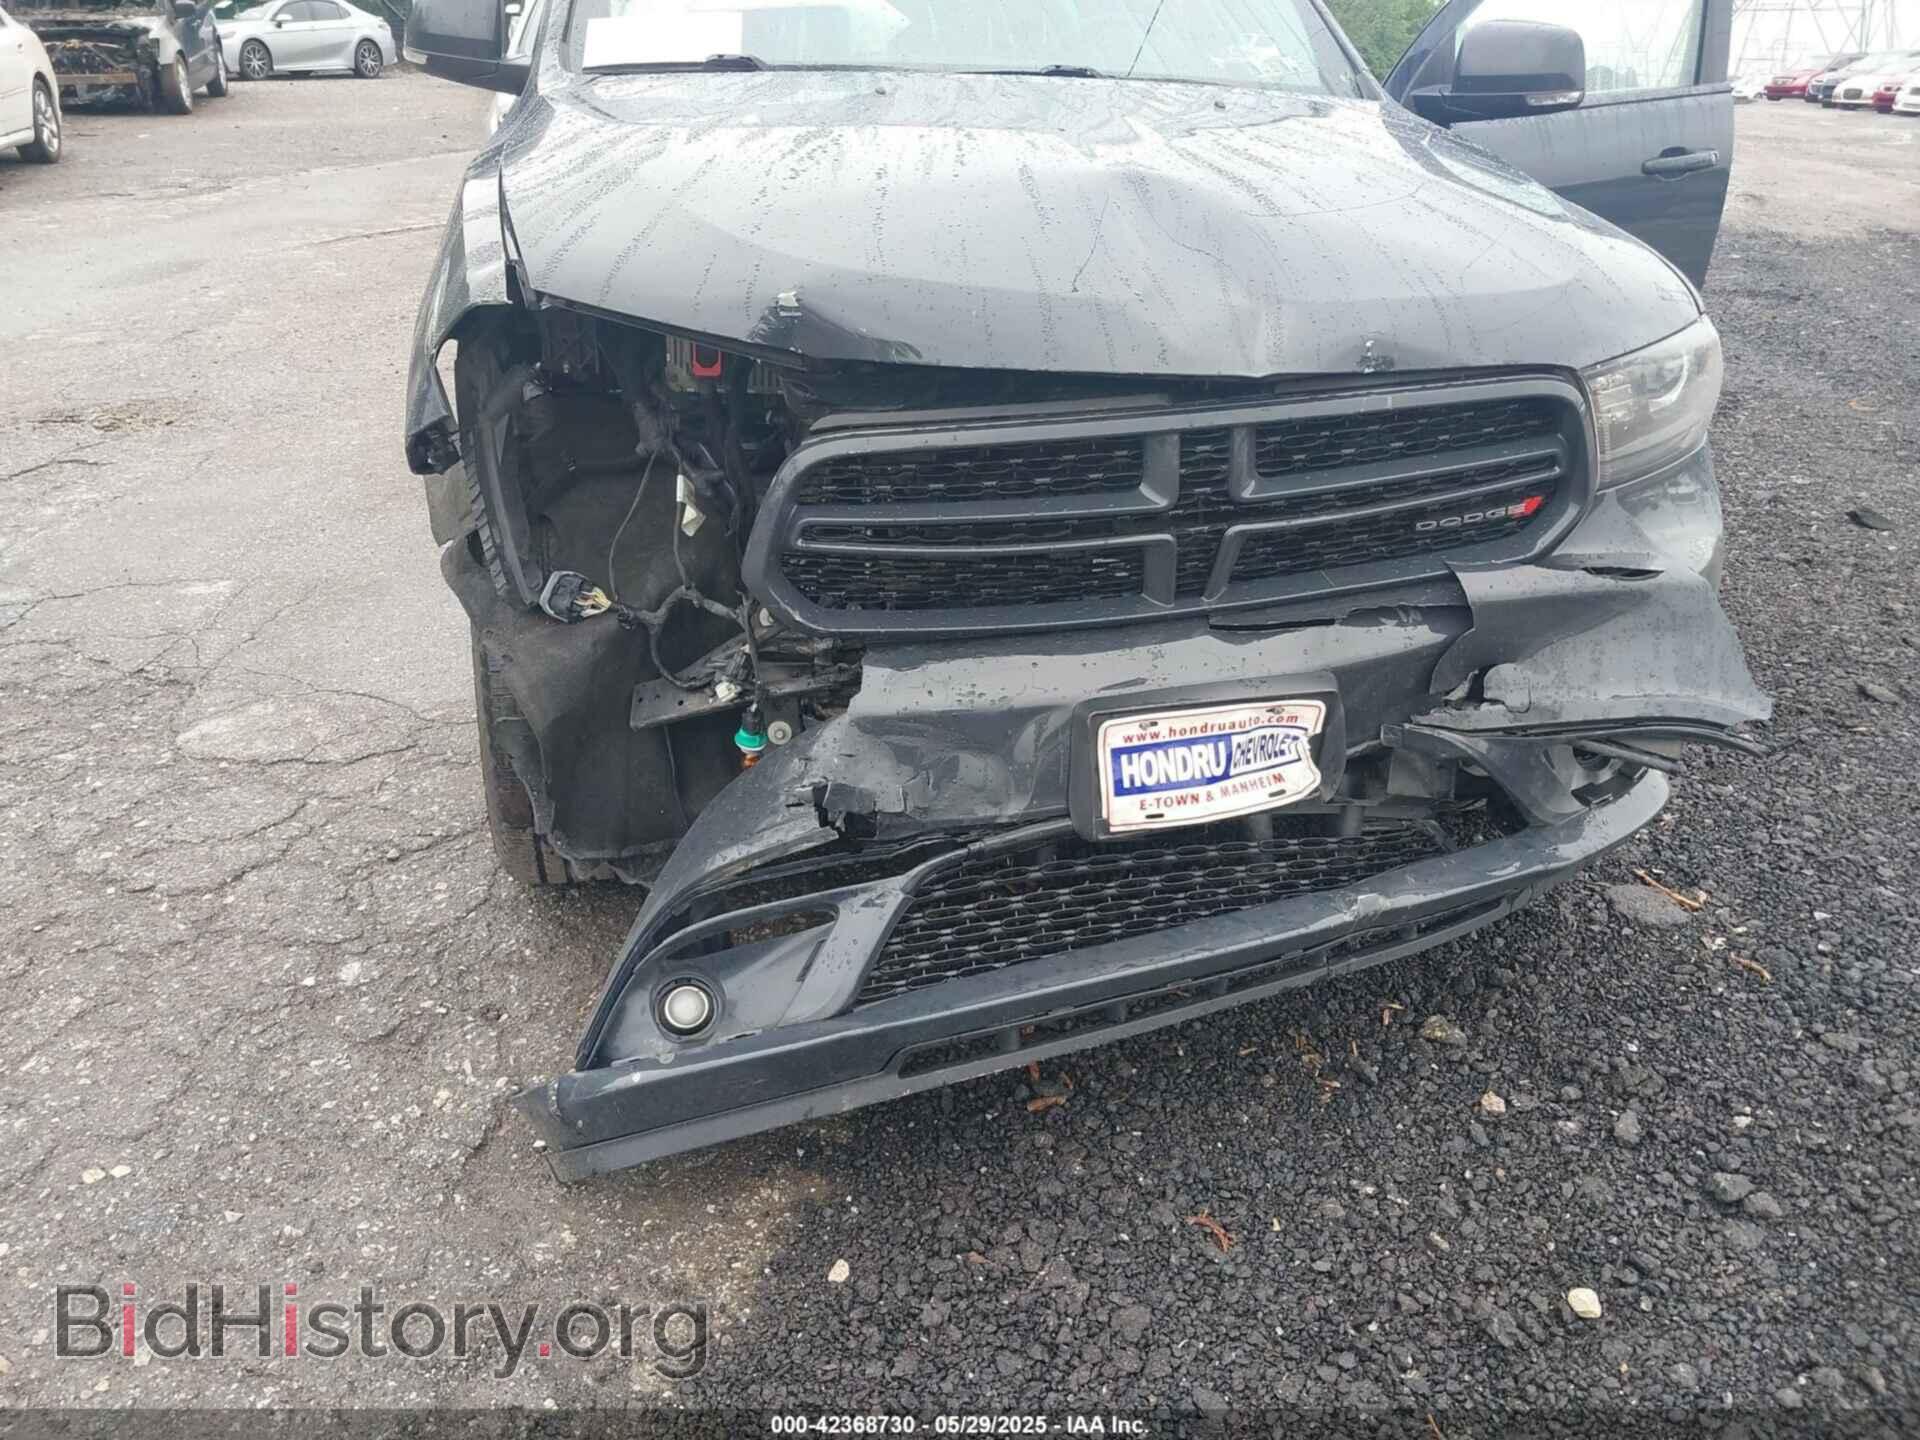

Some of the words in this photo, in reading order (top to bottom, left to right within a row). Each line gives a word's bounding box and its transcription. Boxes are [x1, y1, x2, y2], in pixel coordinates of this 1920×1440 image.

[1416, 504, 1526, 531] DODGE
[1123, 714, 1299, 744] www.hondruauto.com
[1120, 741, 1228, 788] HONDRU
[1232, 733, 1300, 769] CHEVROLET
[1139, 788, 1200, 811] E-TOWN
[1206, 790, 1214, 802] &
[1219, 773, 1286, 798] MANHEIM
